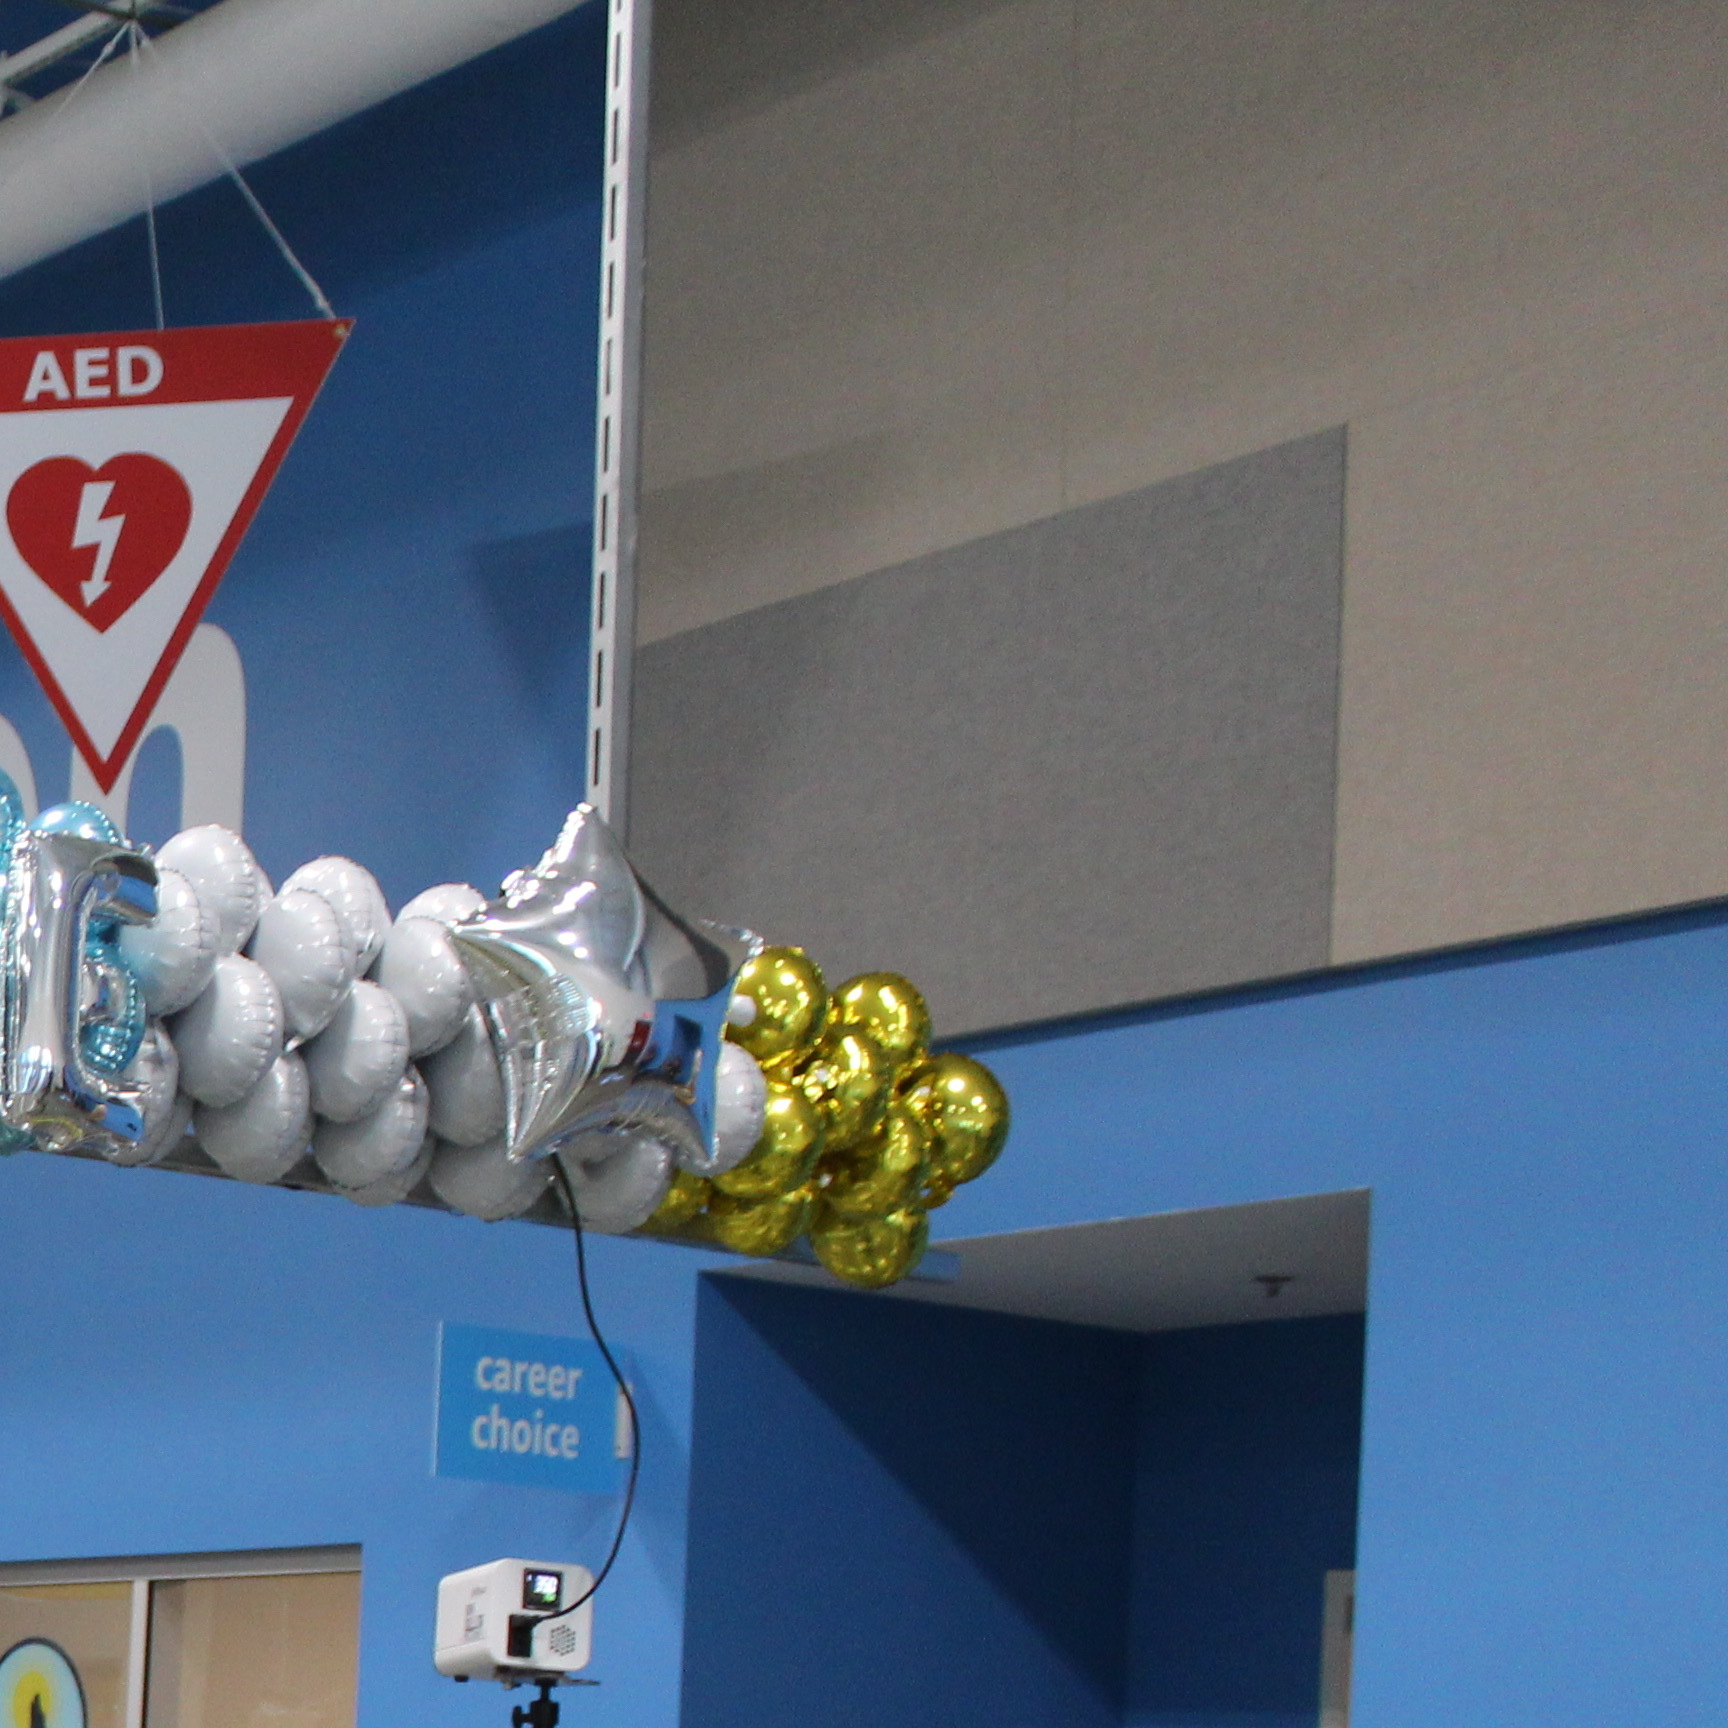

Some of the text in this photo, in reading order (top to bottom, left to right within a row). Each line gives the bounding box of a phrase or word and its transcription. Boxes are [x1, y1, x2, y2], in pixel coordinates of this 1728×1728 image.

[23, 345, 164, 402] AED
[476, 1356, 583, 1399] career
[472, 1403, 580, 1459] choice
